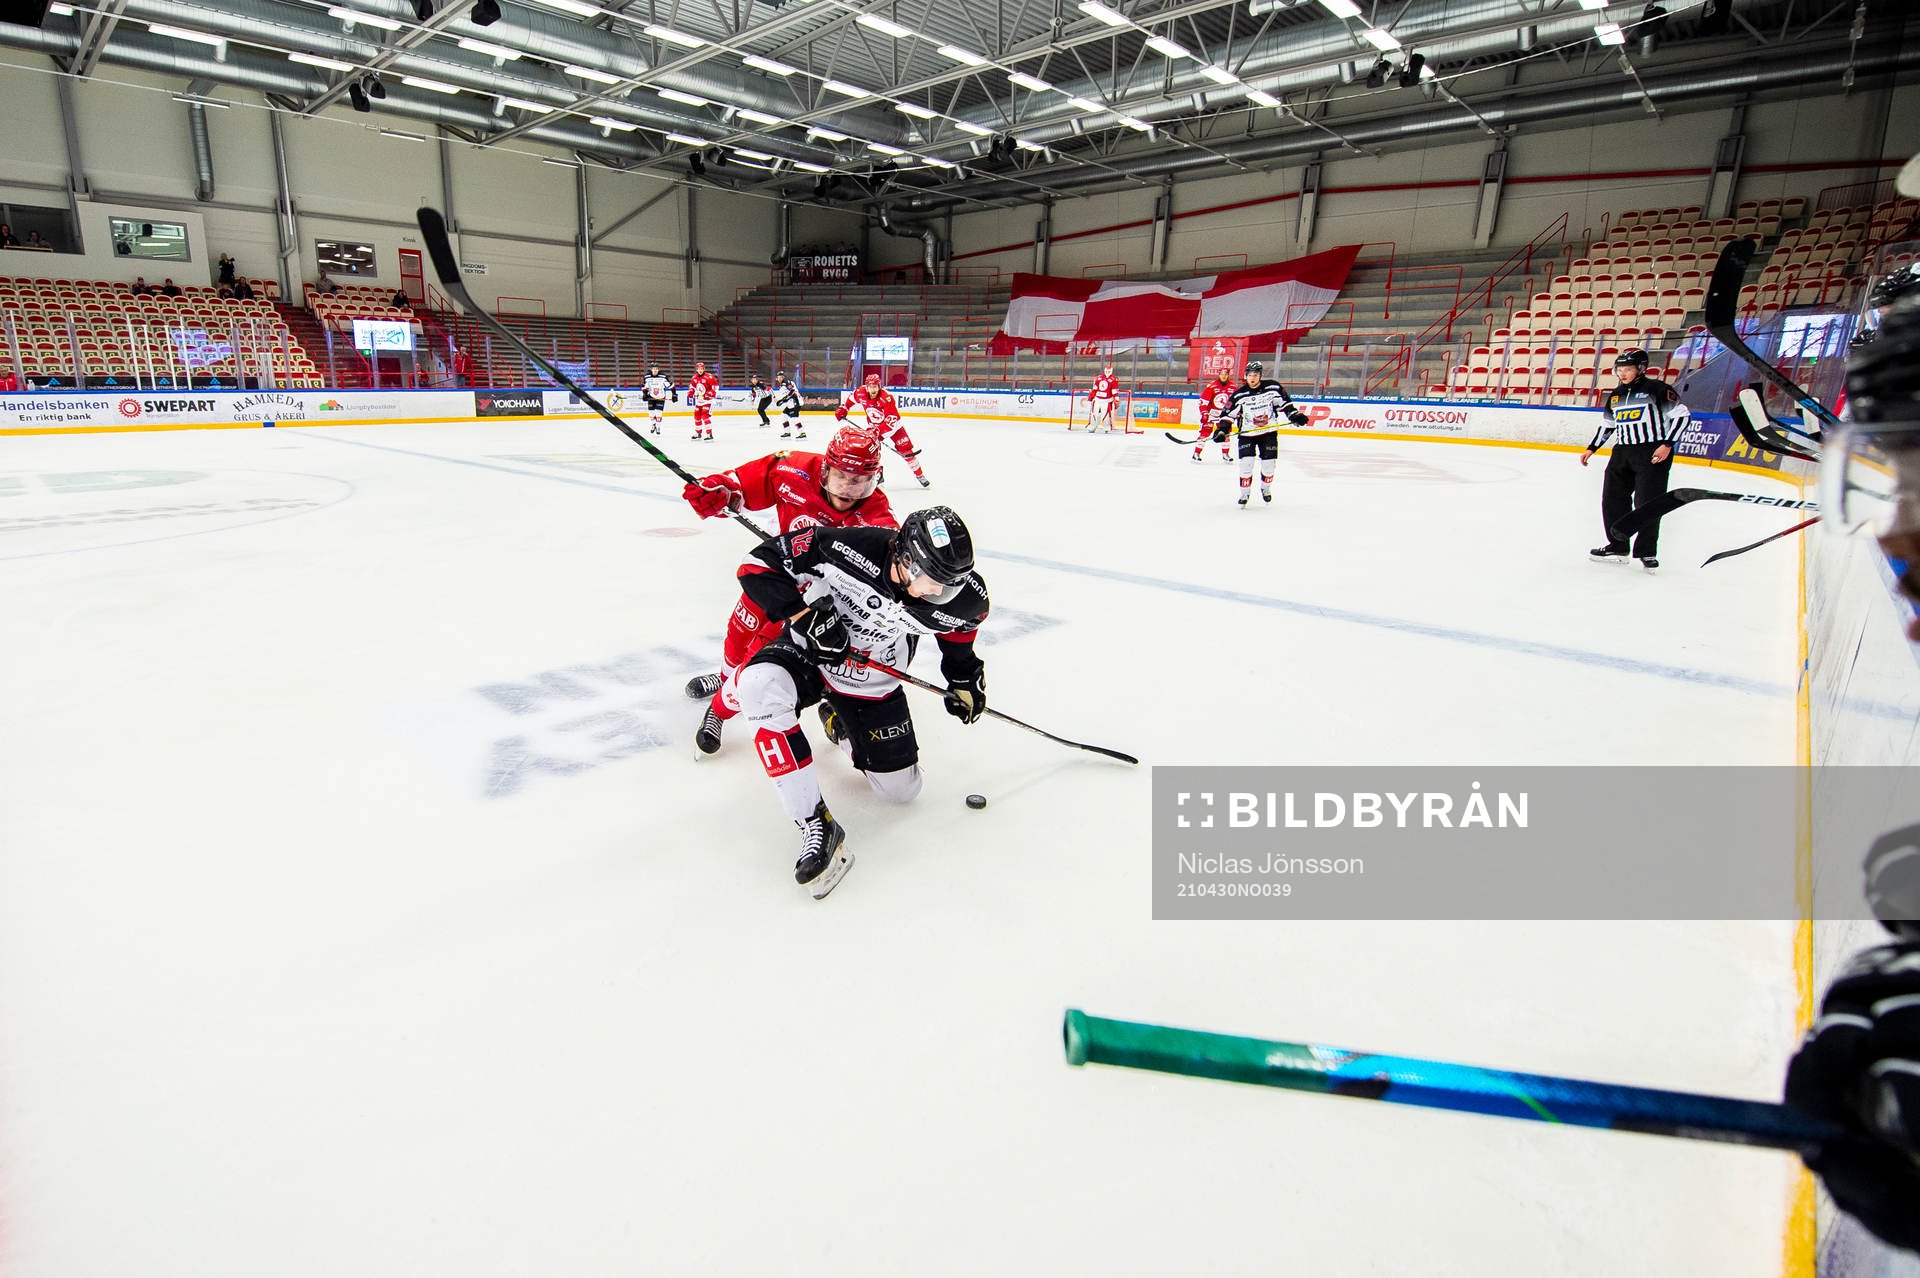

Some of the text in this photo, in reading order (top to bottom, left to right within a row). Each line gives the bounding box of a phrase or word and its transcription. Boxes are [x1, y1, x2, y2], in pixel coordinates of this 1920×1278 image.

[1203, 355, 1235, 369] RED
[0, 400, 110, 411] Handelsbanken
[232, 393, 305, 412] HAMNEDA
[492, 399, 542, 408] YOKOHAMA
[897, 395, 946, 409] EKAMANT
[1018, 394, 1034, 404] GLS
[144, 400, 216, 413] SWEPART
[19, 413, 92, 422] En riktig bank
[233, 413, 261, 421] GRUS
[275, 411, 305, 421] ÅKERI
[1385, 409, 1468, 424] OTTOSSON
[1616, 409, 1641, 420] ATG
[1328, 418, 1376, 429] TRONIC
[1681, 431, 1721, 445] HOCKEY
[1678, 442, 1708, 455] ETTAN
[841, 457, 863, 466] CCM
[831, 540, 881, 576] IGGESUND
[868, 720, 910, 741] XLENT
[758, 738, 786, 768] H
